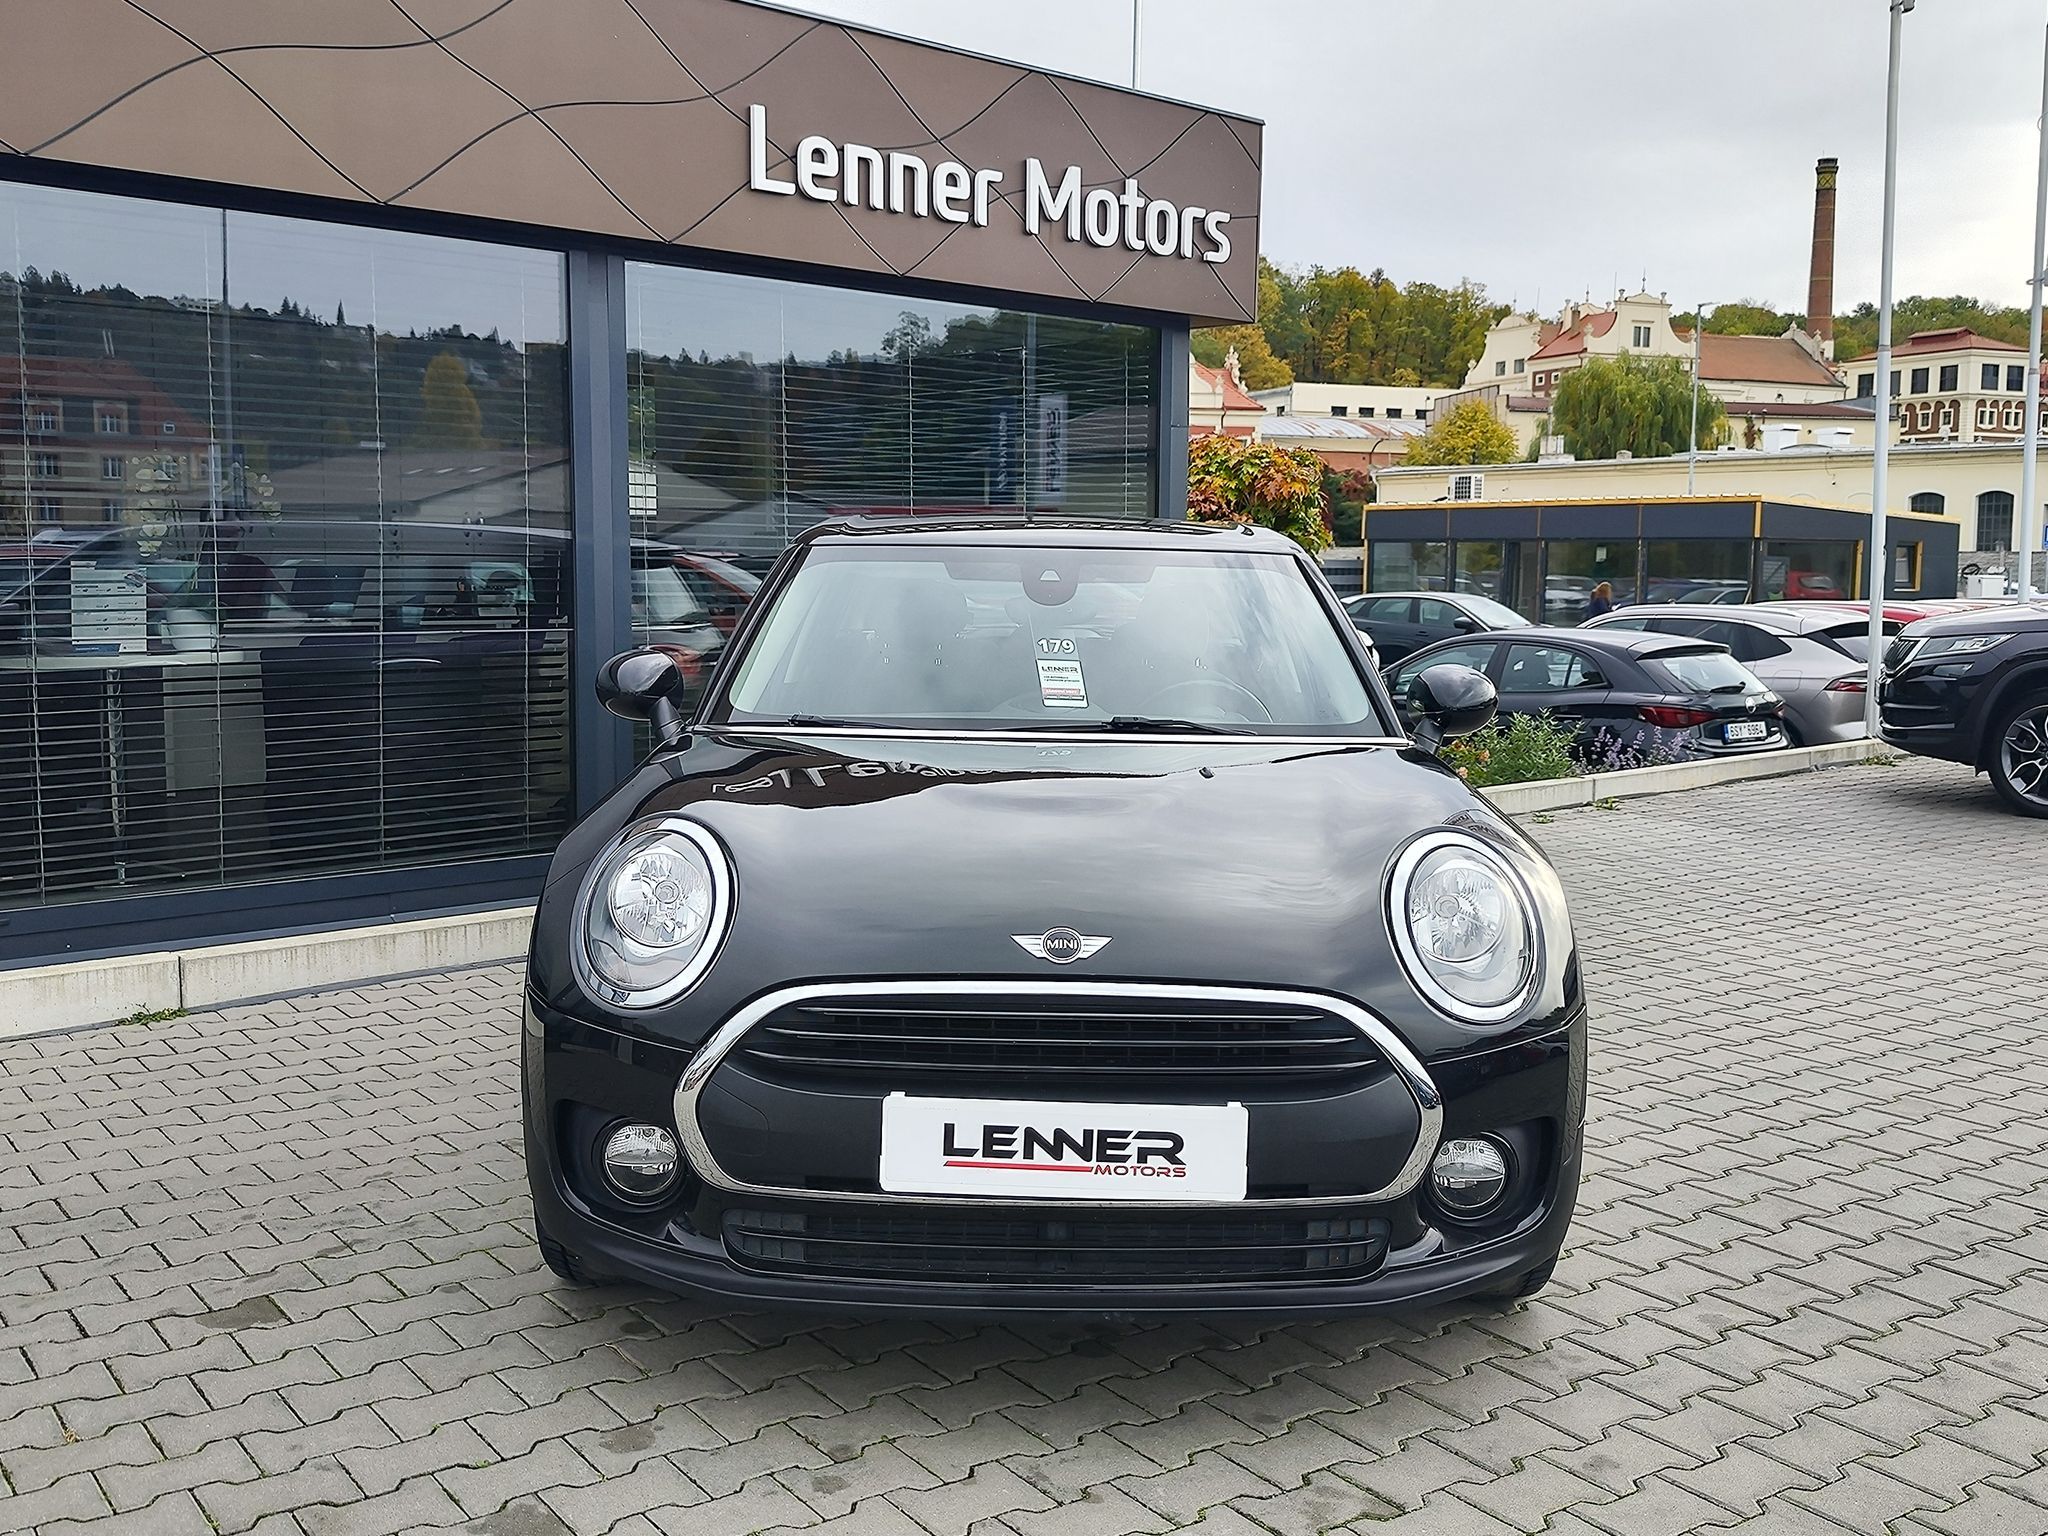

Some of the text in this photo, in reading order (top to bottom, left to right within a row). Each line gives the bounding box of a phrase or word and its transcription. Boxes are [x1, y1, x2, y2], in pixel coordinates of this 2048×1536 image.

[748, 104, 1231, 264] Lenner Motors
[1037, 638, 1076, 654] 179
[1046, 938, 1078, 950] MINI
[943, 1122, 1187, 1166] LENNER
[1093, 1164, 1187, 1178] MOTORS
